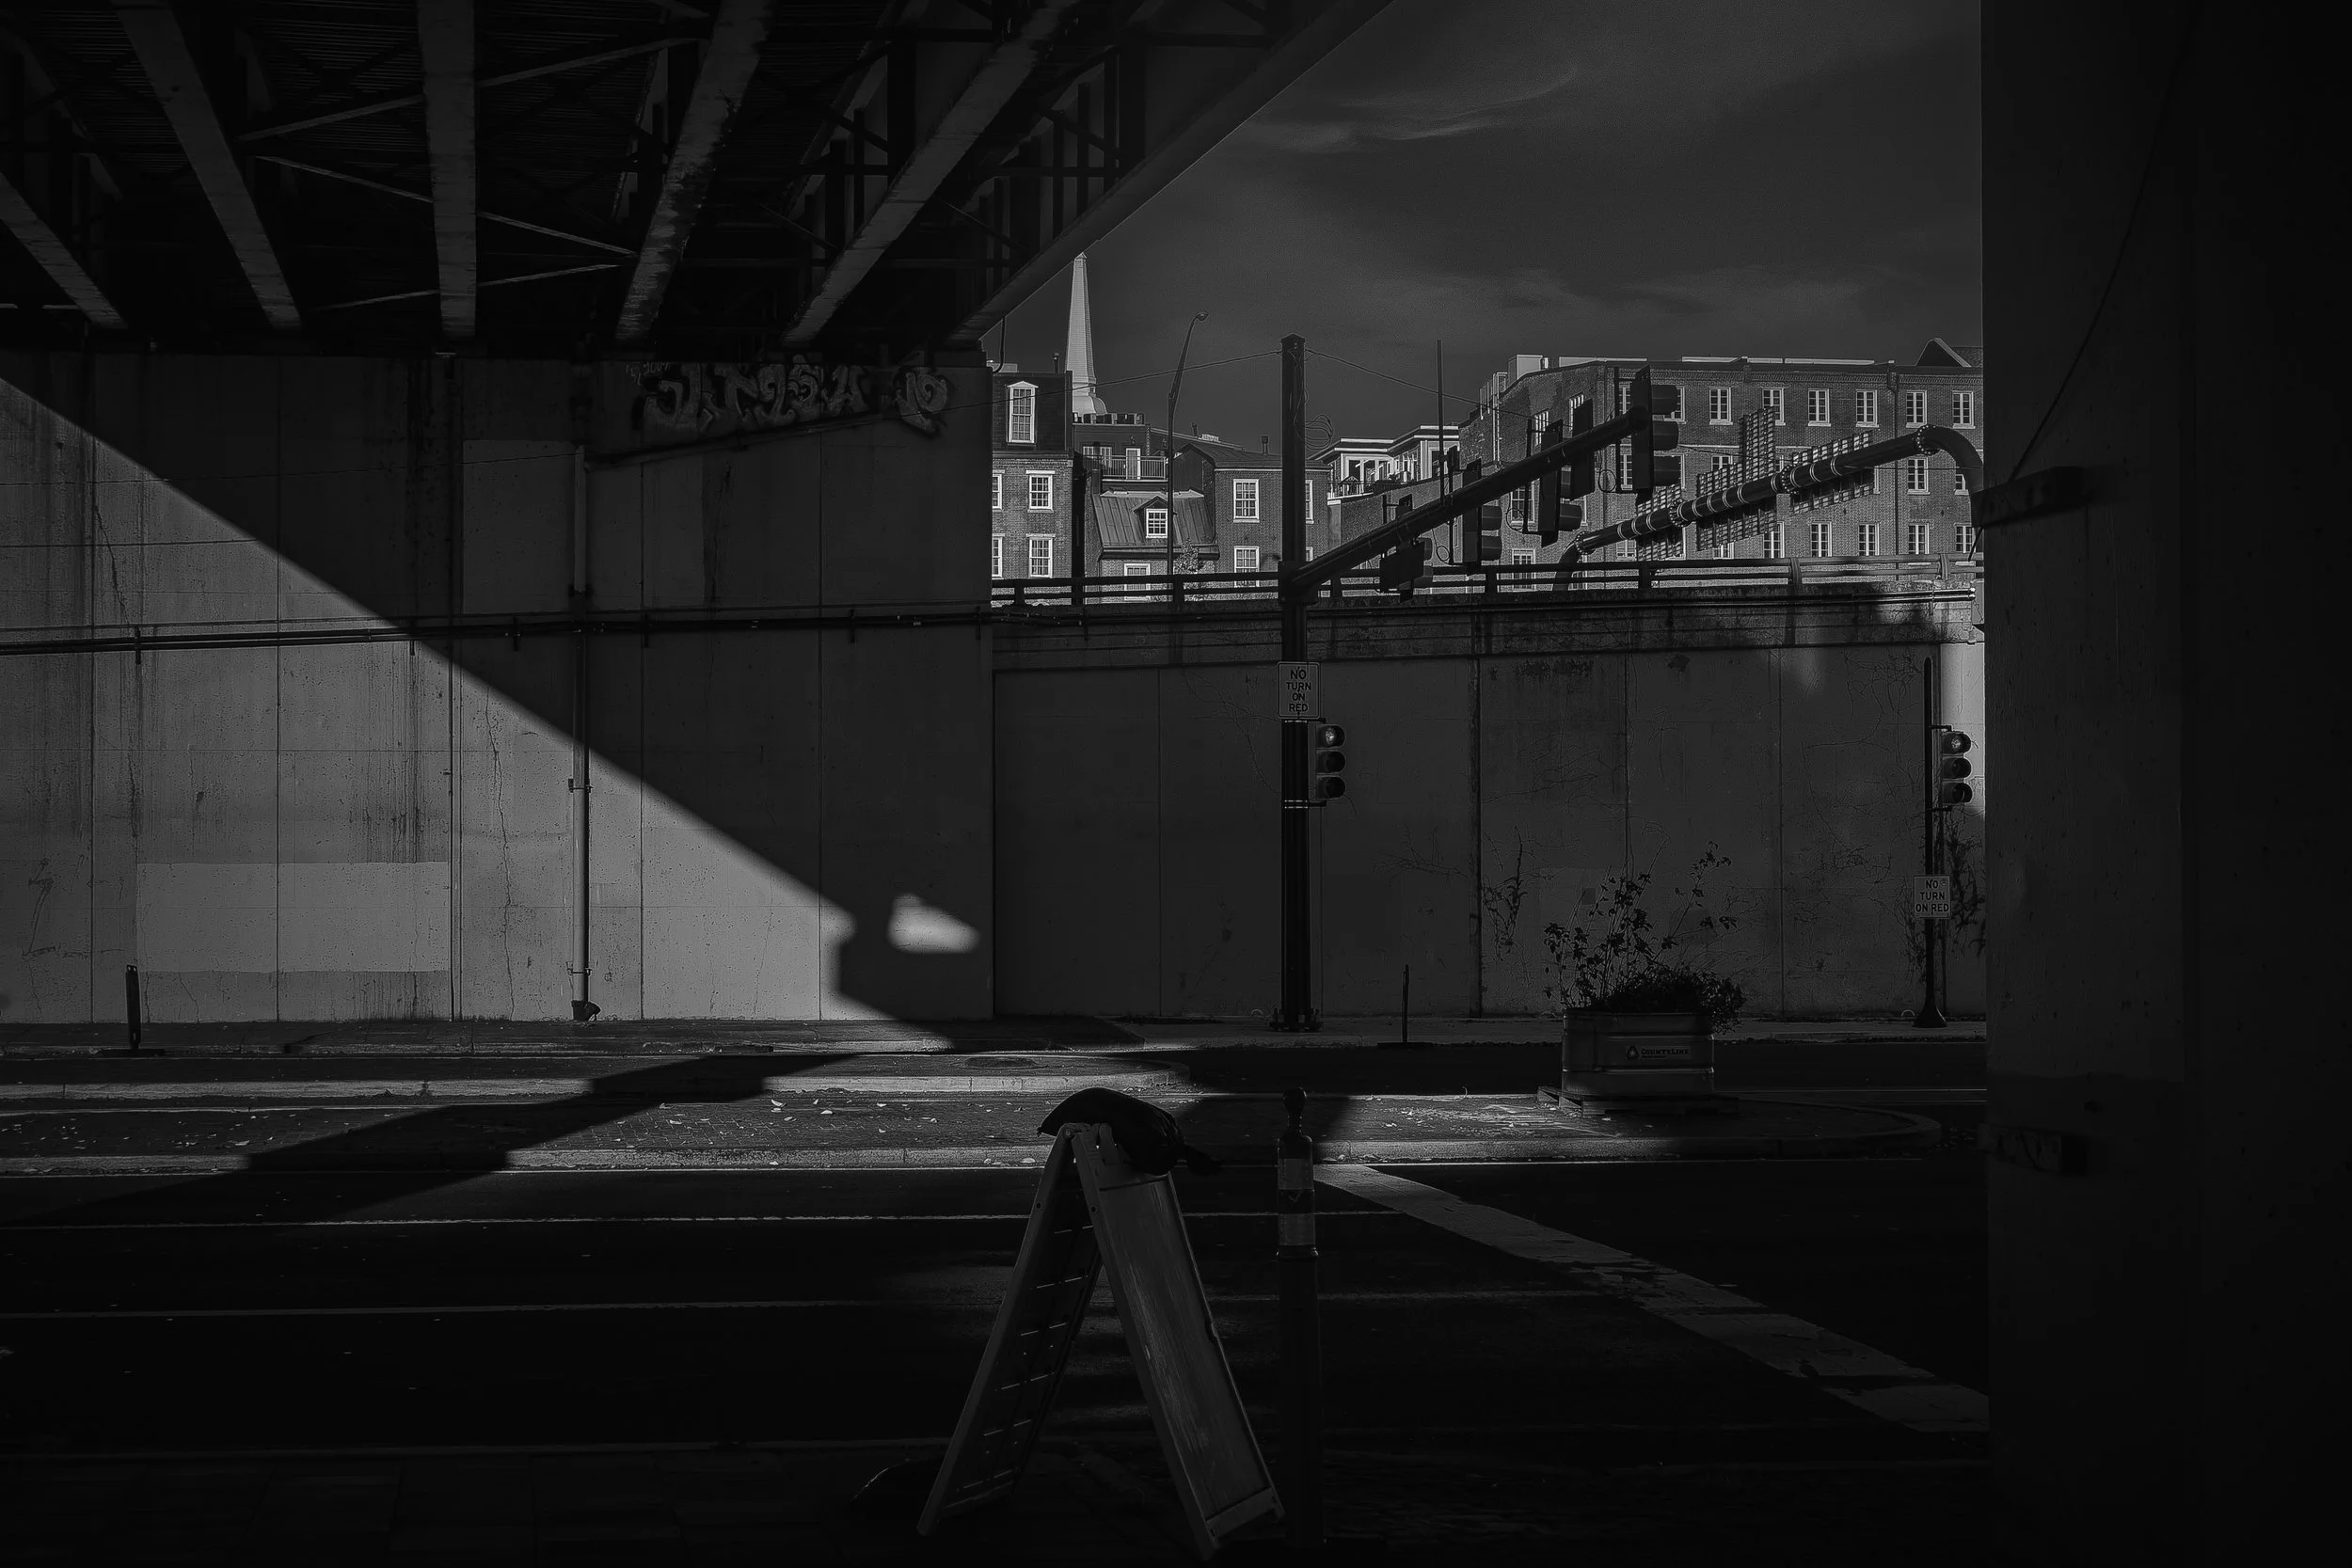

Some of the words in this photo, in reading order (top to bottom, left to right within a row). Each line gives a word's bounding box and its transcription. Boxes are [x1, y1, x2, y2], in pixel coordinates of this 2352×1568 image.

[1290, 669, 1307, 680] NO
[1286, 682, 1311, 690] TURN
[1292, 692, 1306, 702] ON
[1289, 703, 1309, 712] RED
[1926, 879, 1939, 889] NO
[1920, 892, 1946, 900] TURN
[1915, 903, 1929, 912] ON
[1931, 903, 1949, 912] RED
